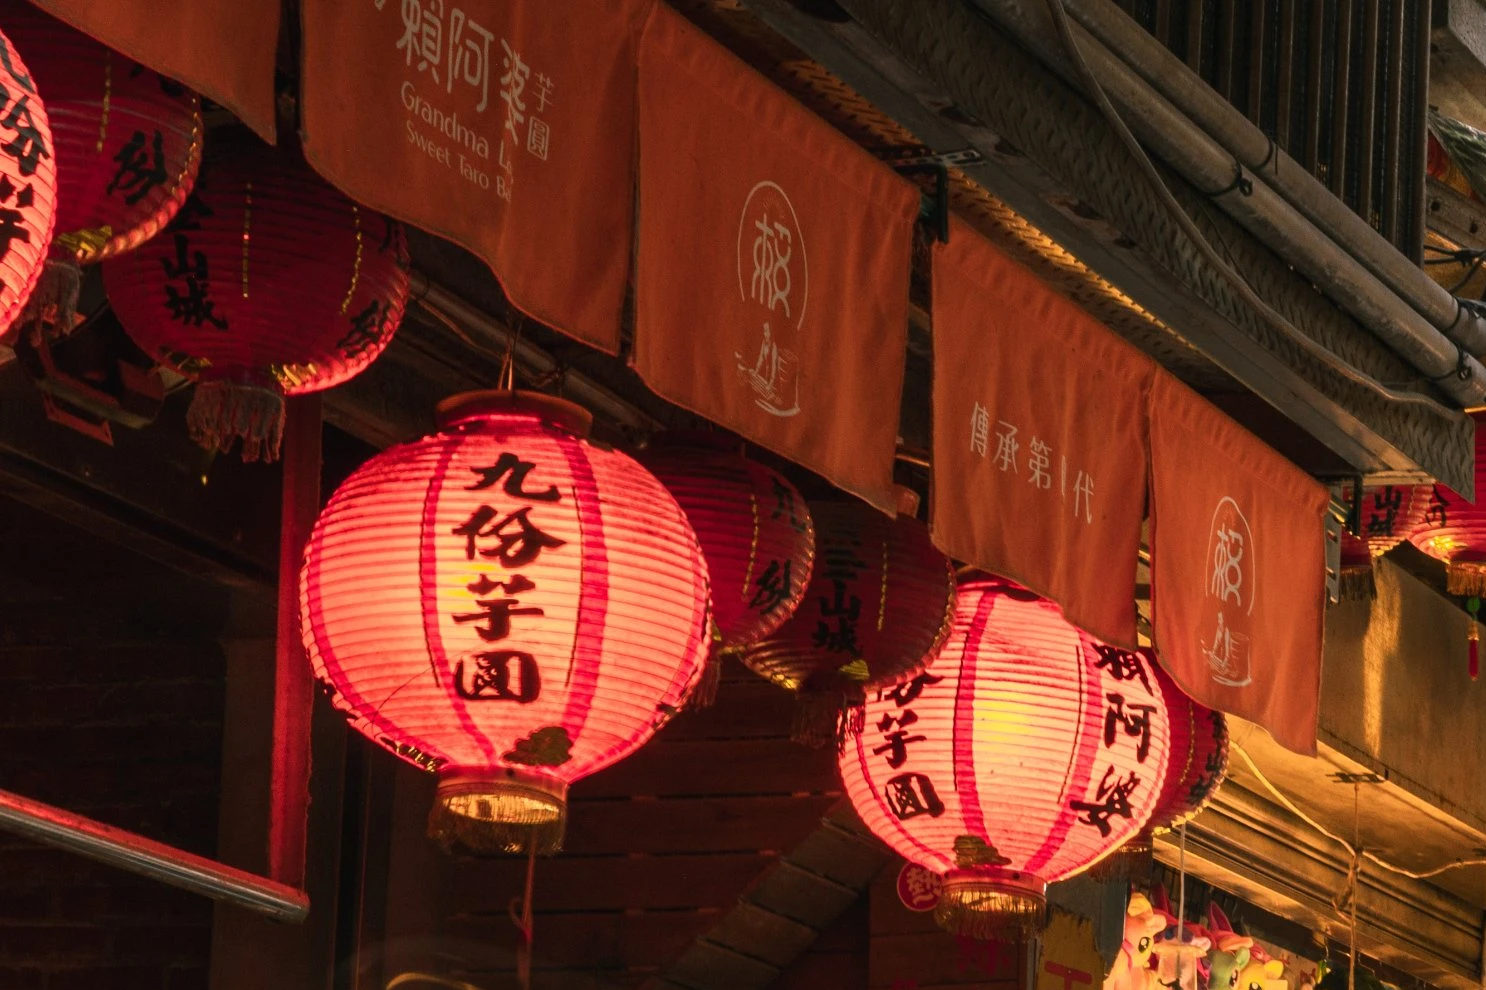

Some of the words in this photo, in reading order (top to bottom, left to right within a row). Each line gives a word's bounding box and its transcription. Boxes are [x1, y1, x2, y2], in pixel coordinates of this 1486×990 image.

[401, 80, 490, 160] Grandma
[406, 119, 452, 169] Sweet
[457, 153, 490, 190] Taro
[969, 400, 1096, 525] 傳承第代
[451, 452, 567, 704] 九份芋圓
